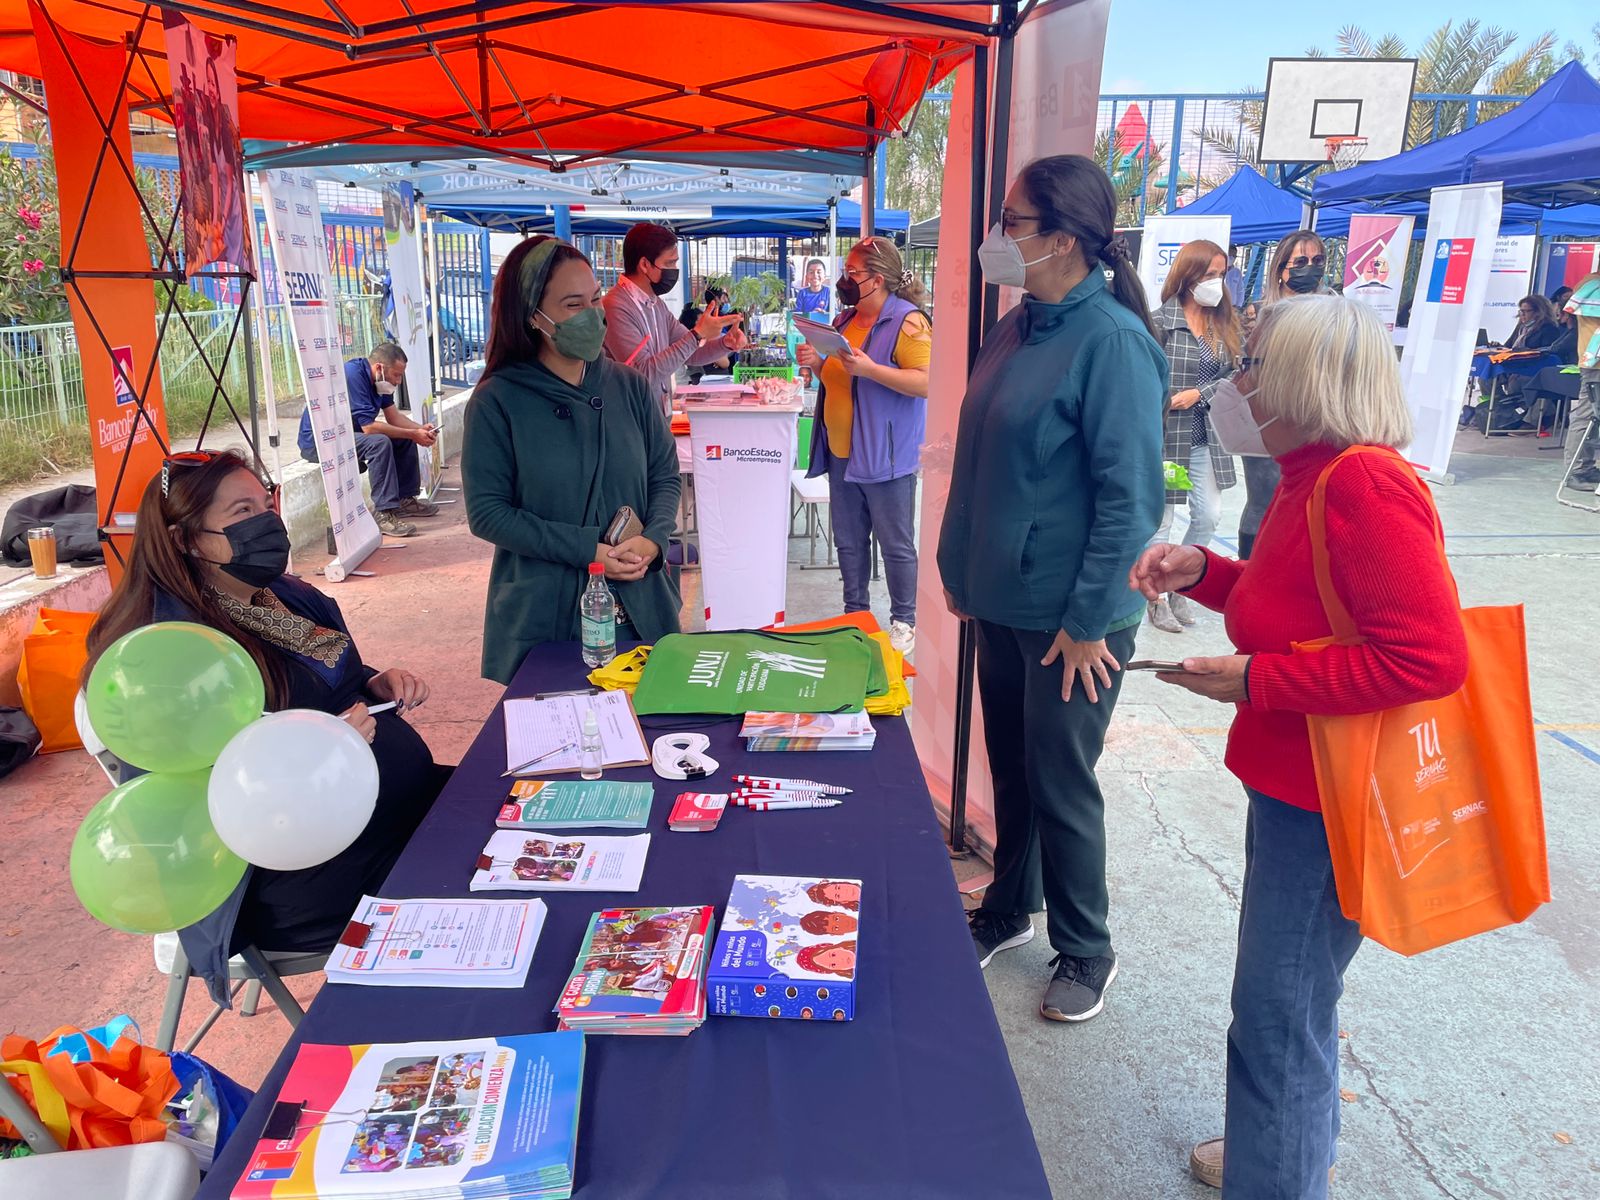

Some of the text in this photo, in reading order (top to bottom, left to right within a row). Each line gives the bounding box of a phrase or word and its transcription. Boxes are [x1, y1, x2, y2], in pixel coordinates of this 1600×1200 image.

[1158, 249, 1178, 266] SE
[723, 447, 782, 458] BancoEstado
[736, 456, 781, 464] Microempresas
[687, 650, 724, 688] JUNJI
[1408, 717, 1442, 768] TU
[1414, 757, 1446, 783] SERNAC
[1452, 800, 1486, 820] SERNAC
[720, 953, 731, 968] Niños
[726, 936, 736, 950] niñas
[731, 936, 747, 968] del Mundo
